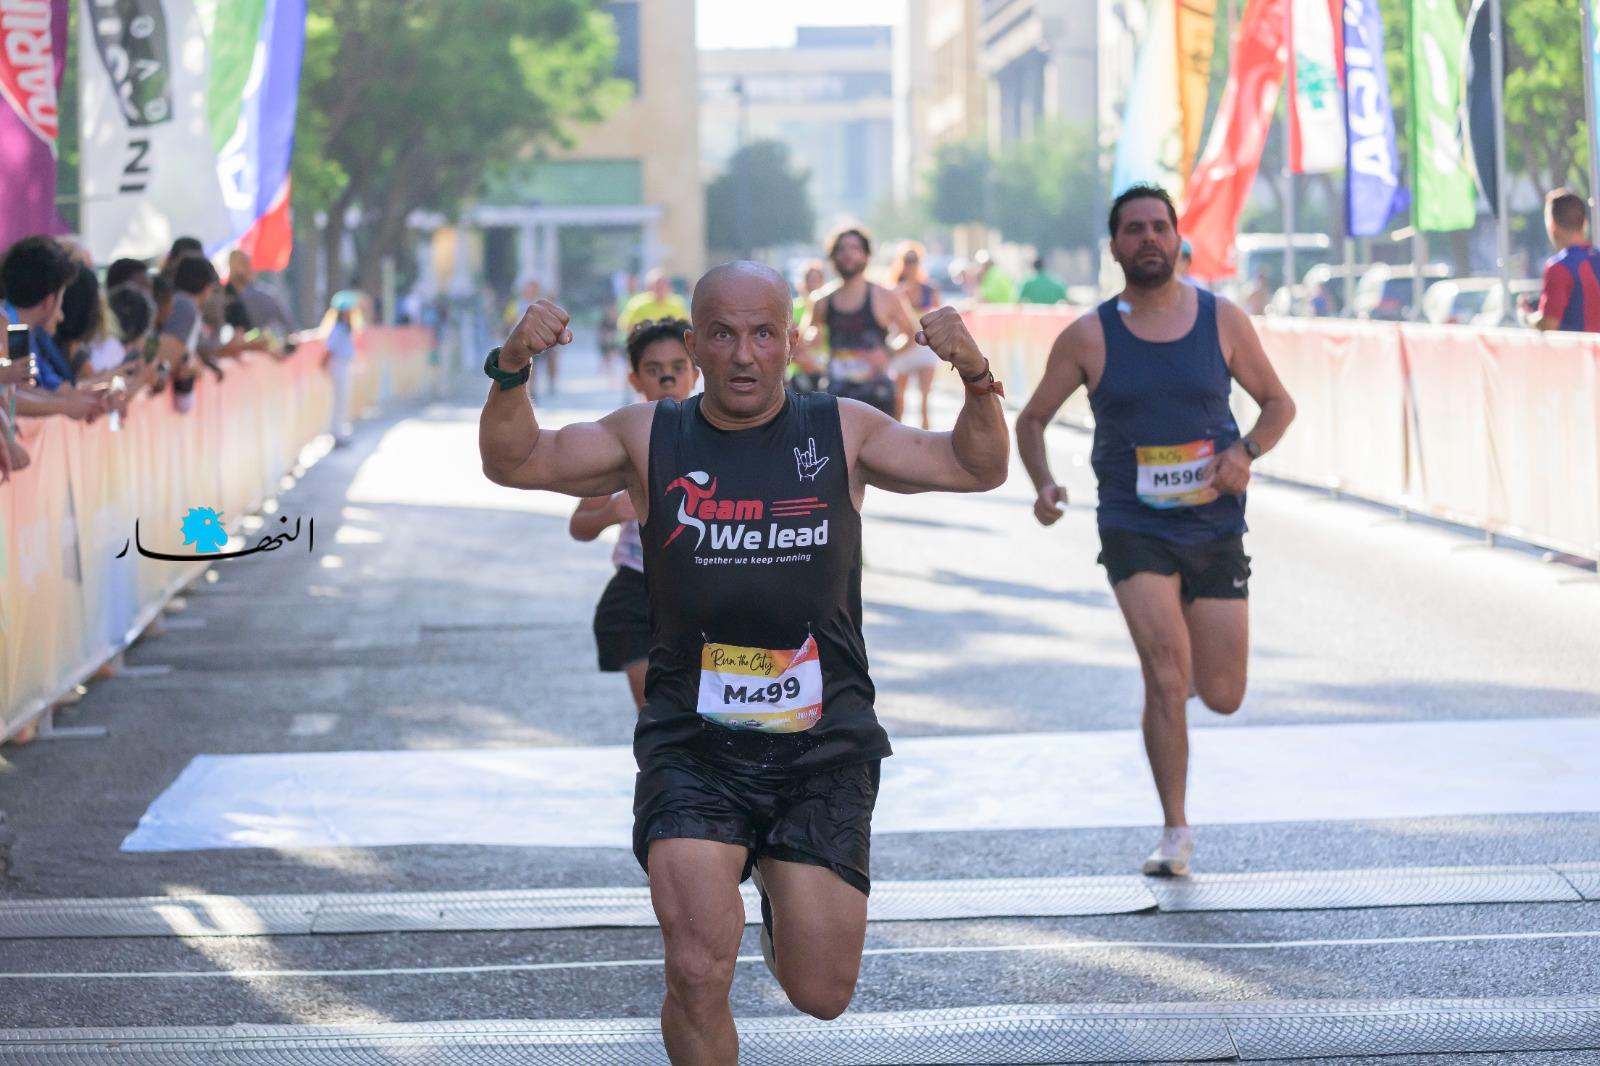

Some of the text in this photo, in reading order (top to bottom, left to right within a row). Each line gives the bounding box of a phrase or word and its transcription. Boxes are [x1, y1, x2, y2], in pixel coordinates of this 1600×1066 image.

[664, 476, 764, 521] Team
[710, 519, 829, 550] We lead
[694, 552, 812, 566] Together we keep running
[711, 648, 774, 676] Run the City
[724, 676, 801, 705] M499
